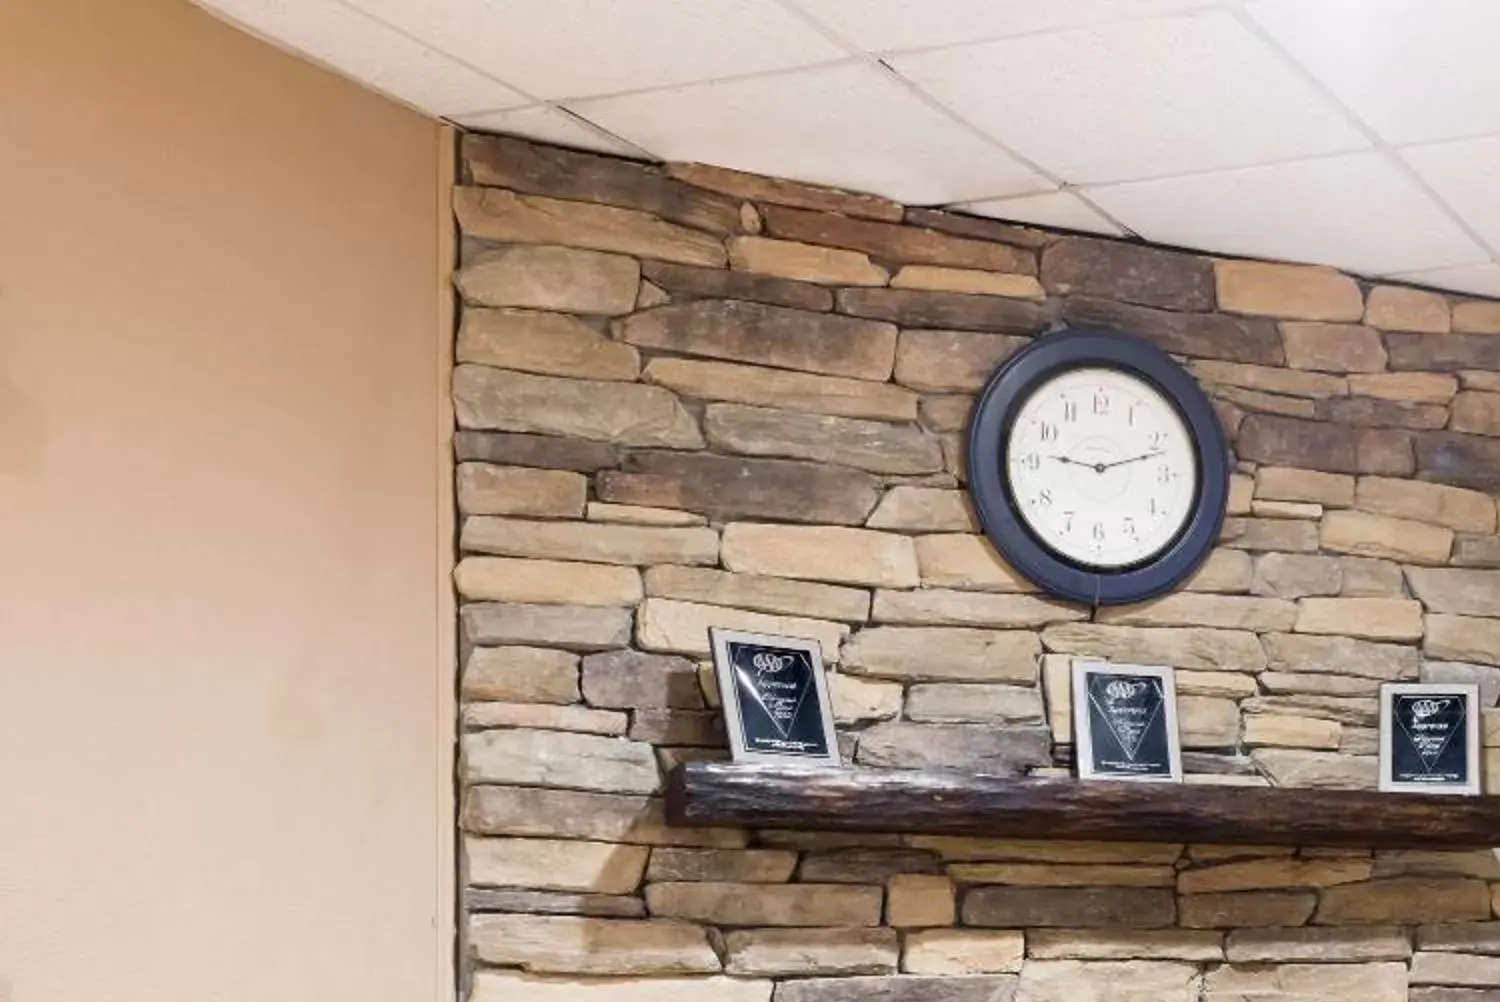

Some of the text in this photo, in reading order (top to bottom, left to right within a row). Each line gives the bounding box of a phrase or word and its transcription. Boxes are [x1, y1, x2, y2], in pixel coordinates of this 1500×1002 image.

[1064, 400, 1077, 423] 11
[1092, 393, 1110, 415] 12
[1040, 421, 1060, 443] 10
[1148, 431, 1161, 451] 2
[1027, 453, 1040, 471] 9
[1157, 464, 1170, 482] 3
[1039, 487, 1053, 505] 8
[1063, 511, 1075, 532] 7
[1123, 516, 1135, 535] 5
[1093, 522, 1105, 541] 6
